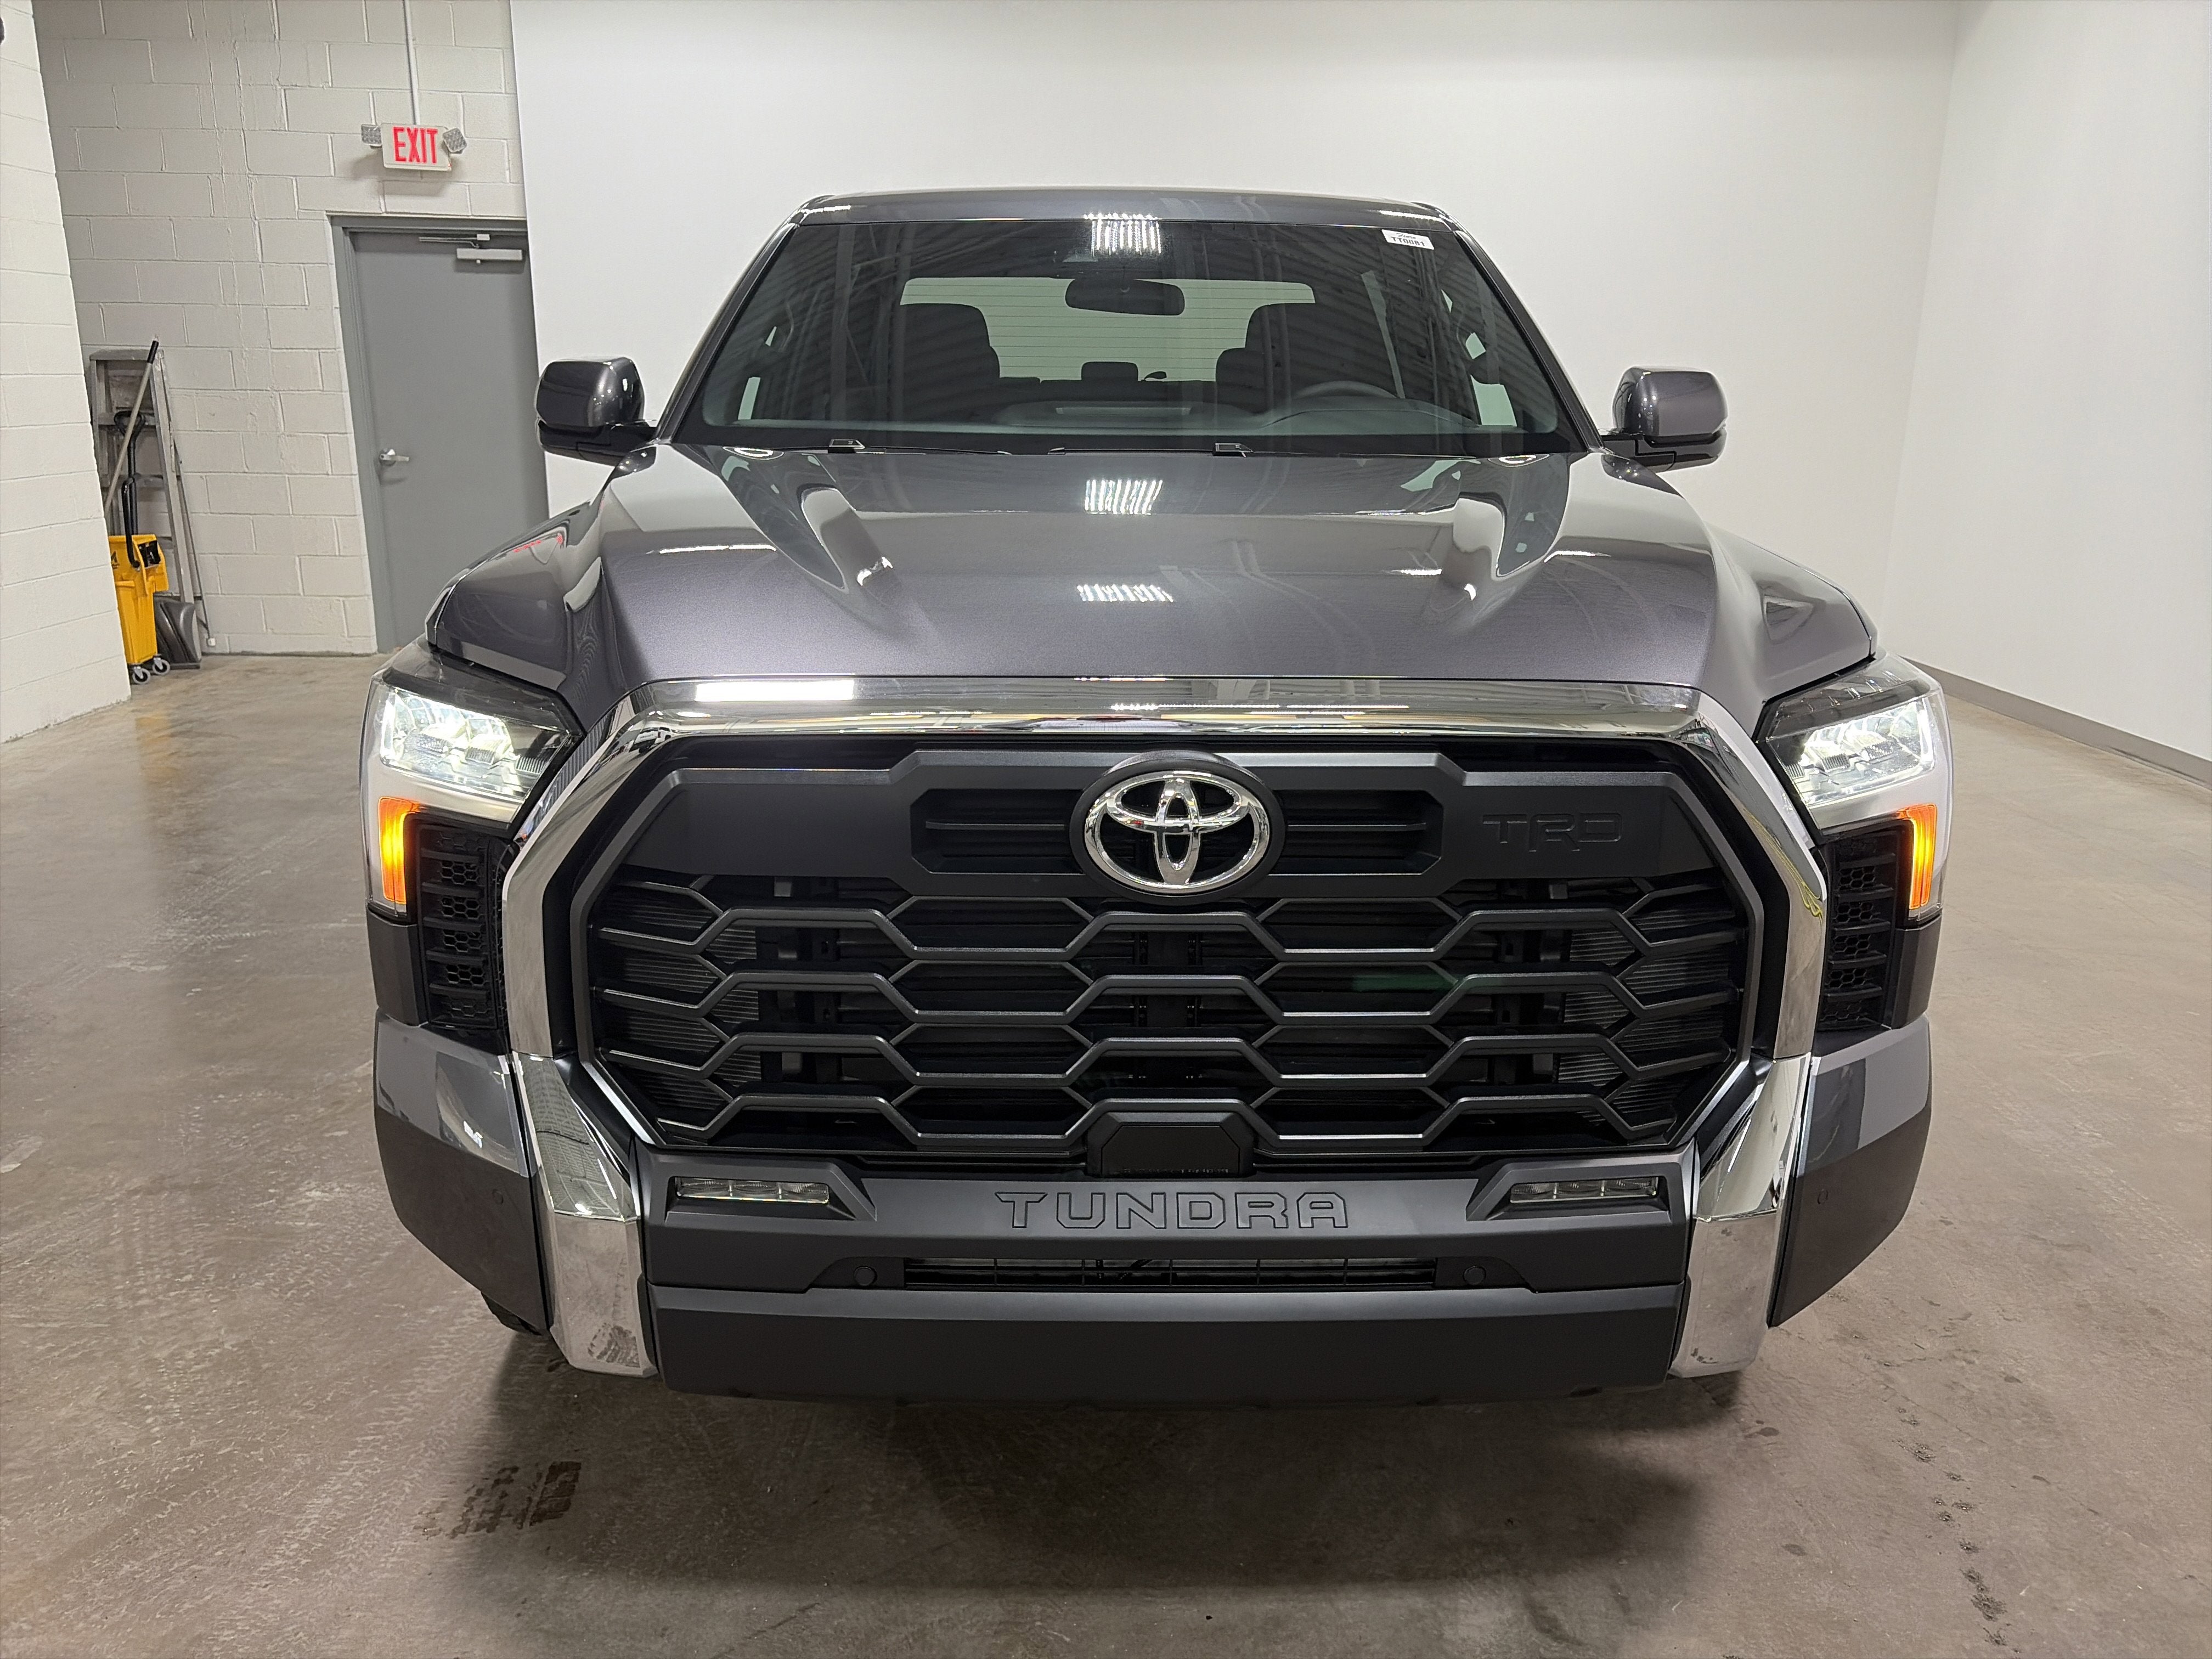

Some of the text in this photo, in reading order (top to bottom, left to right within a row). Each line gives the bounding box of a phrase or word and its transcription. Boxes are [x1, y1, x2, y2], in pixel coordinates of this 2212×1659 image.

[392, 126, 438, 164] EXIT
[1390, 236, 1425, 247] TT0081
[1482, 812, 1623, 852] TRD
[994, 1192, 1349, 1229] TUNDRA
